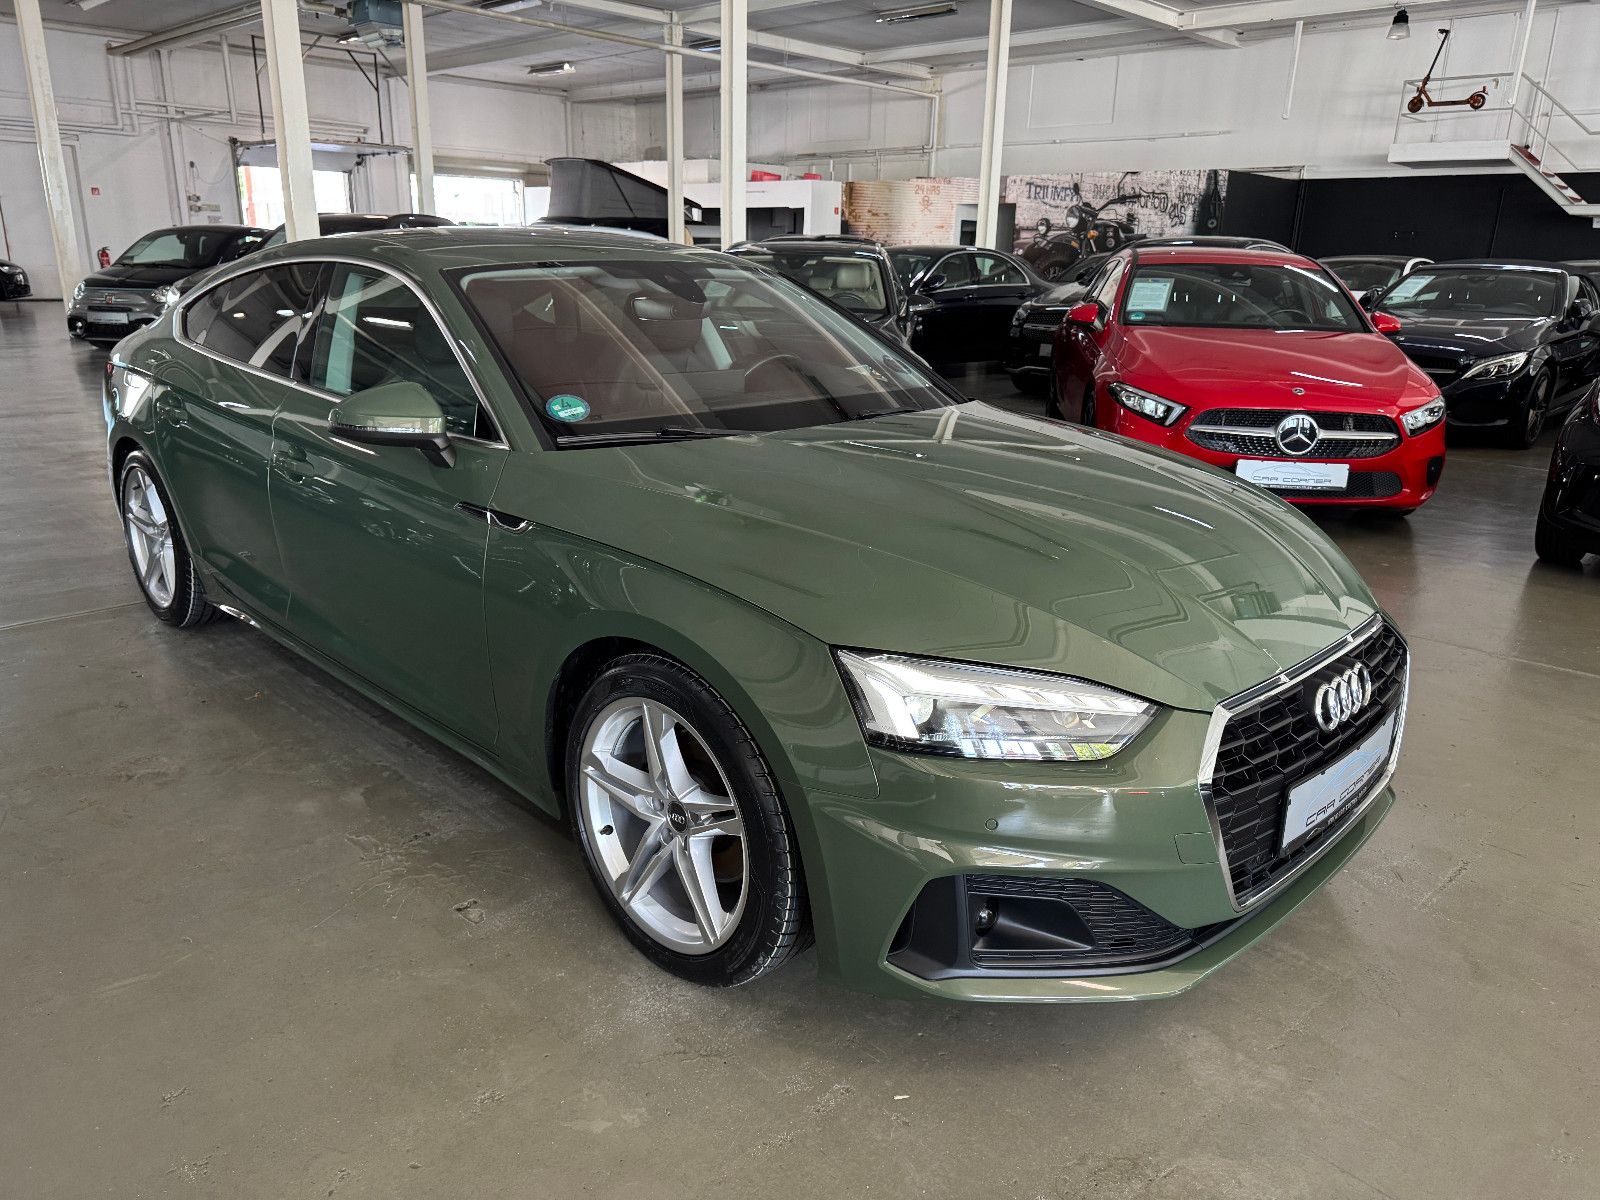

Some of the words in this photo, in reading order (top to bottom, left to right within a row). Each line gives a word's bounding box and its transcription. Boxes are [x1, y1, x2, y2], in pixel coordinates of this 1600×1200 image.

[1282, 476, 1332, 484] CORNER
[1305, 798, 1336, 828] CAR
[1338, 754, 1381, 803] CORNER
